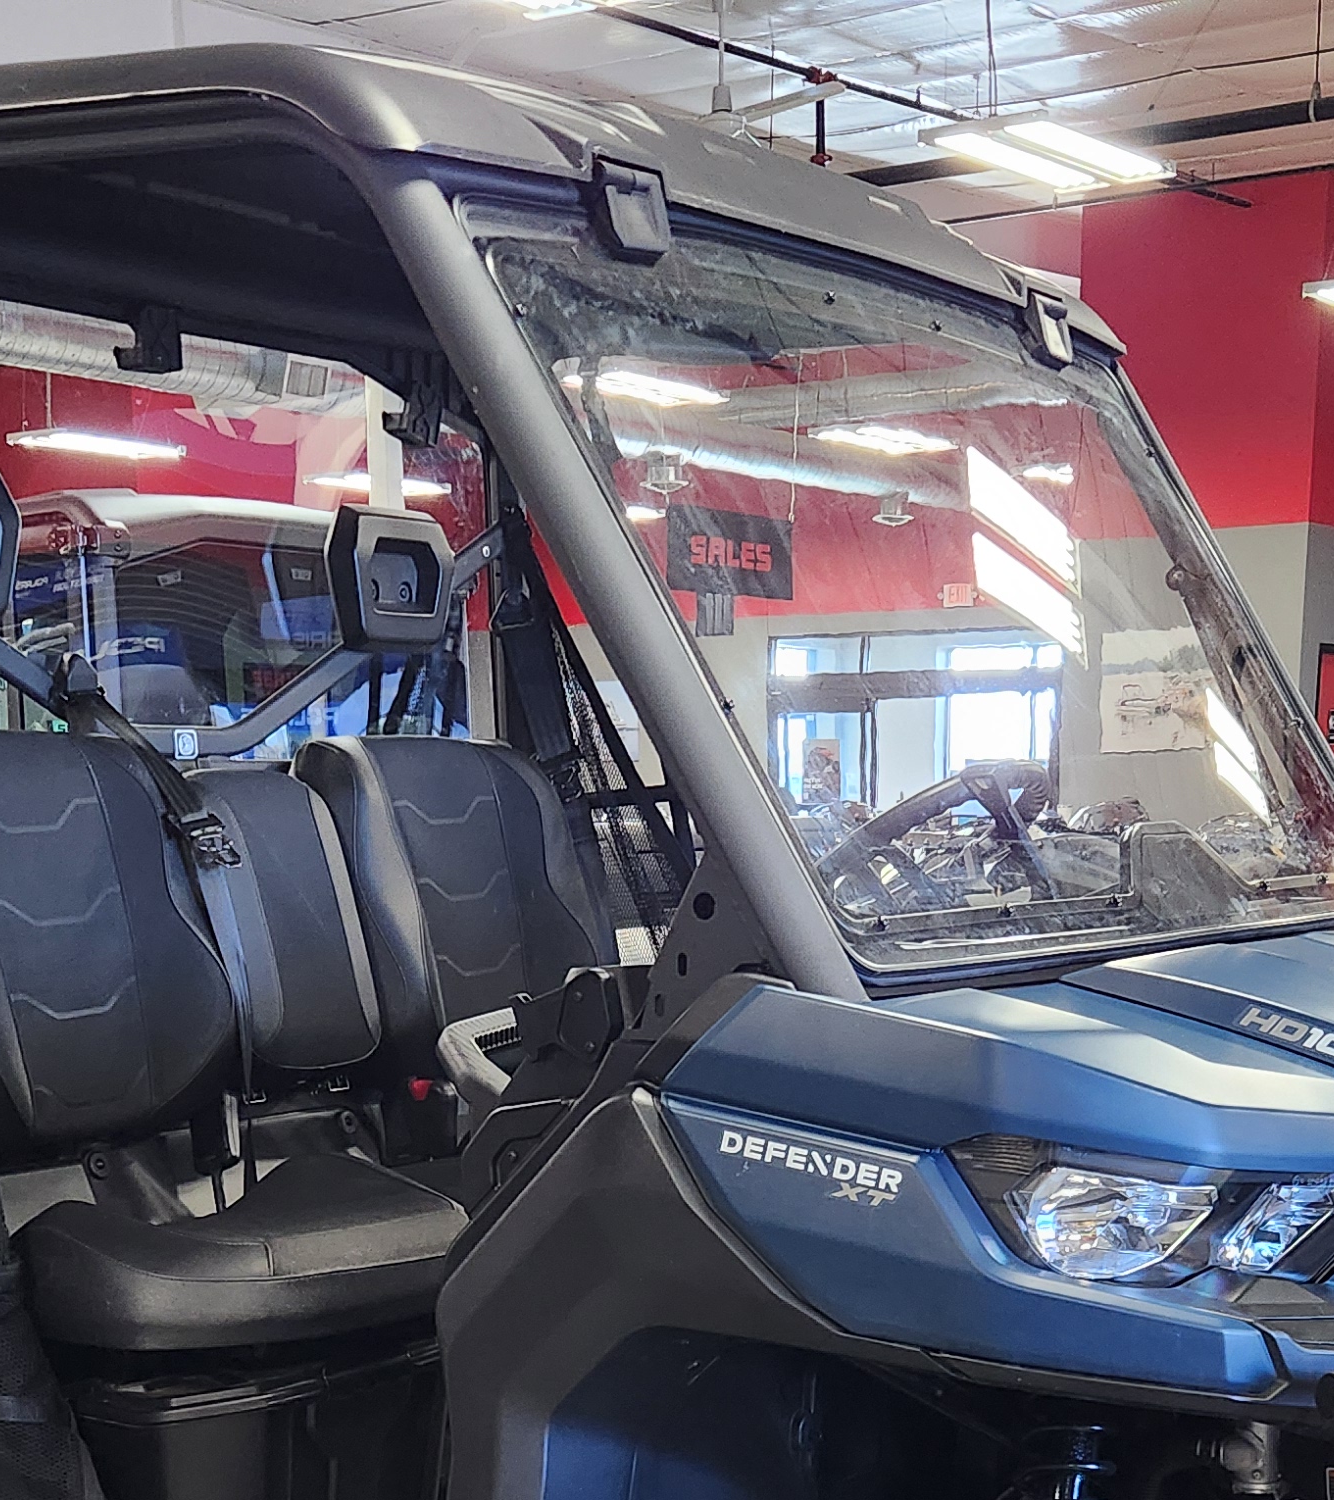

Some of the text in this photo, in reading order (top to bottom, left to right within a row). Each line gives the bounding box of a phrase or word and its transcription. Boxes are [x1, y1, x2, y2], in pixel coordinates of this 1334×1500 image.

[690, 534, 772, 572] SALES
[719, 1129, 903, 1193] DEFENDER
[831, 1182, 897, 1207] XT
